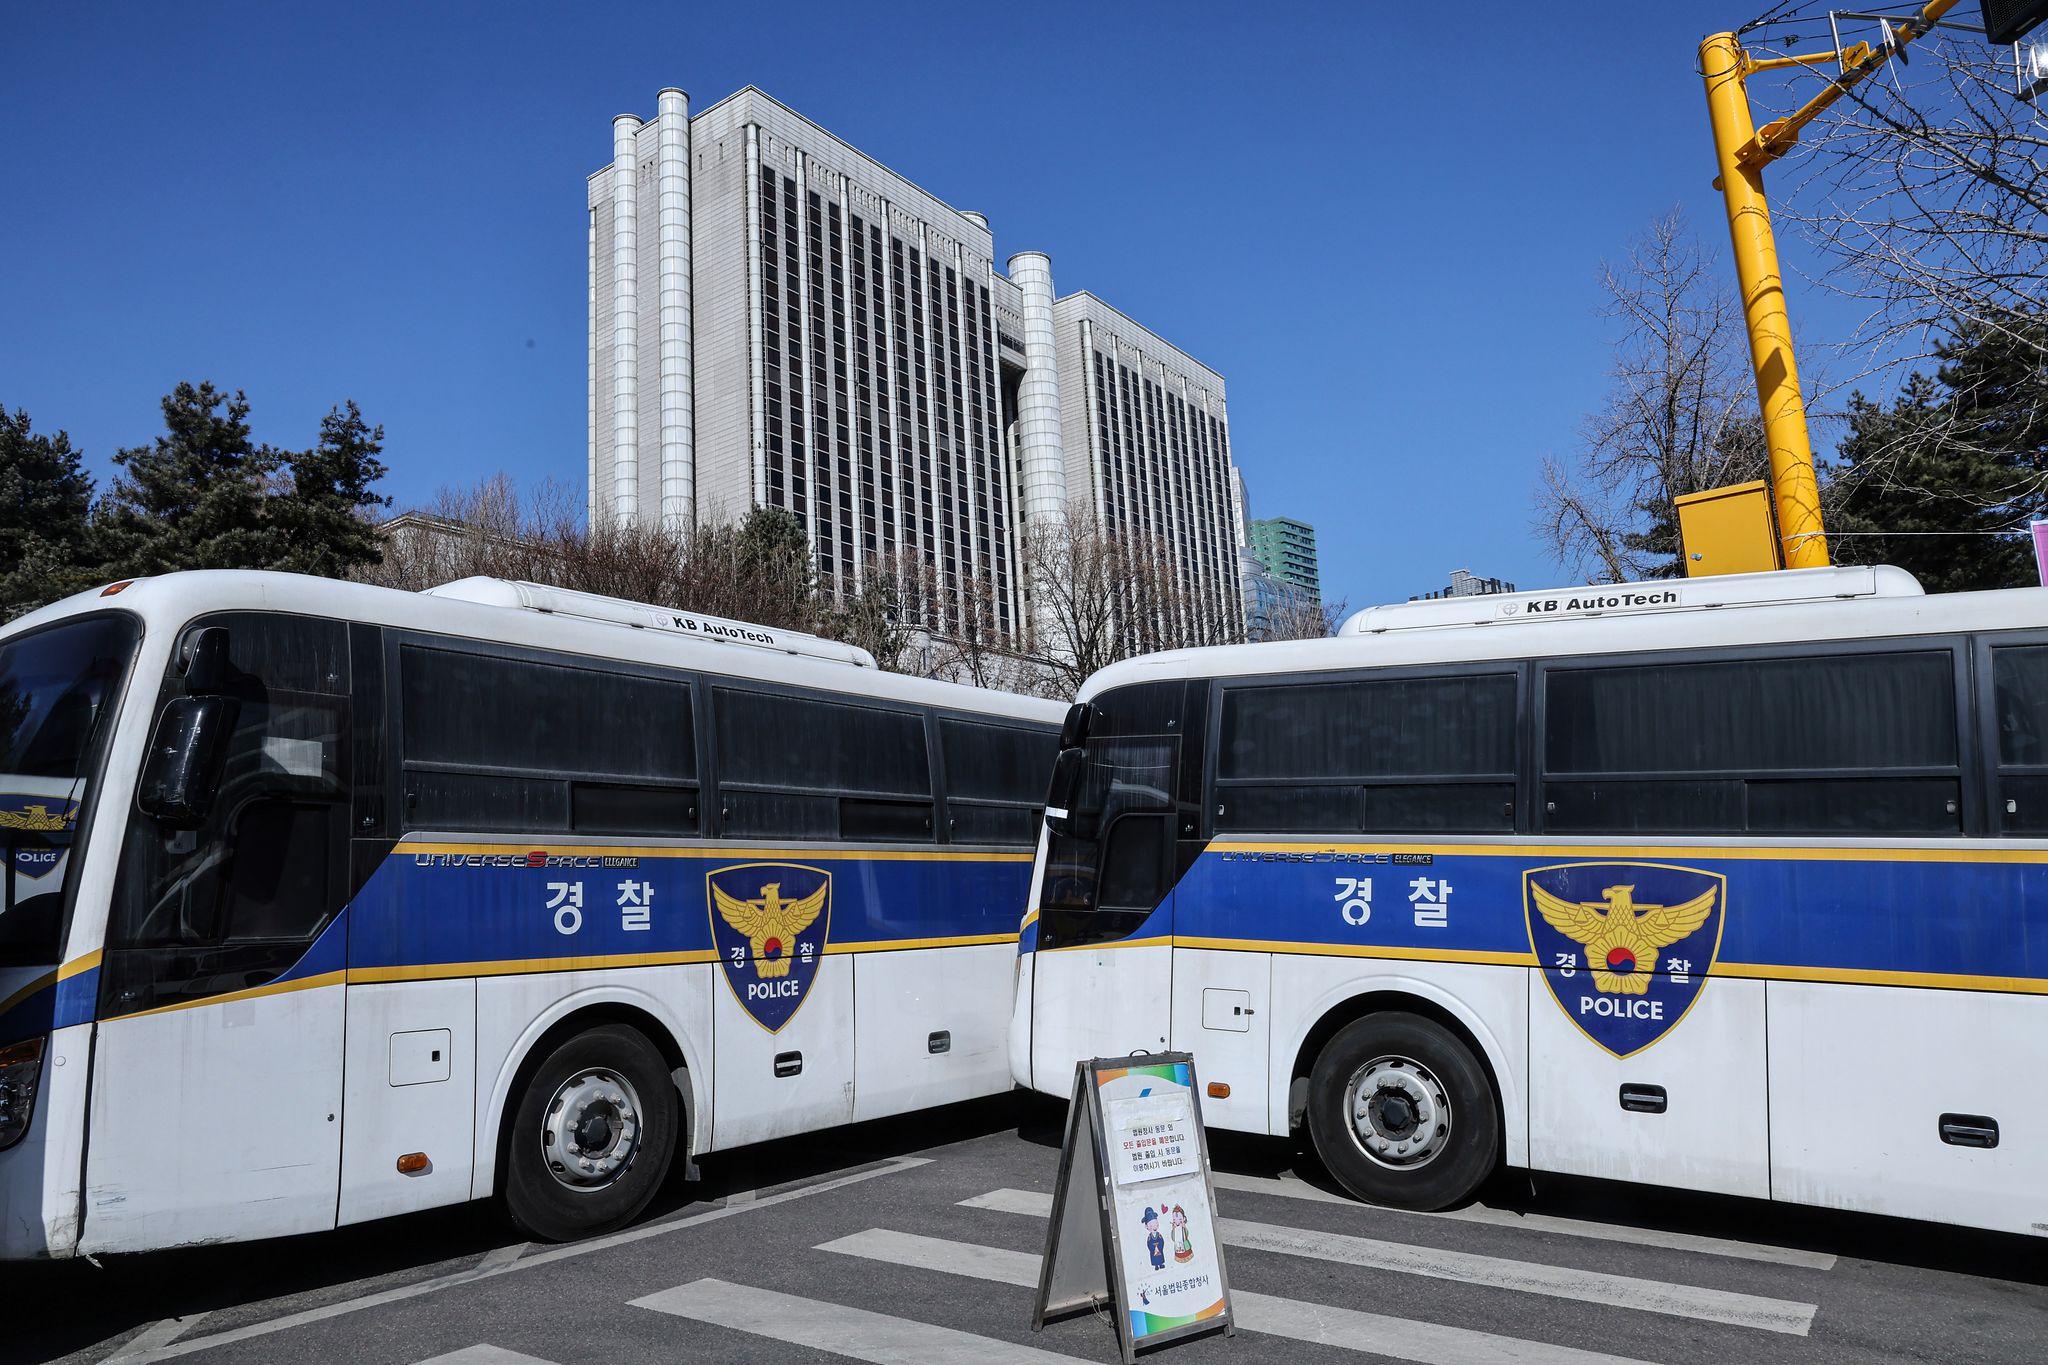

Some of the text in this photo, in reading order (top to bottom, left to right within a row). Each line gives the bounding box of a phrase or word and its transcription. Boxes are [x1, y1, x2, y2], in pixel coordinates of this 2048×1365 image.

[1527, 591, 1677, 613] KB AutoTech
[672, 617, 774, 644] KB AutoTech
[604, 856, 638, 867] ELEGANCE
[1394, 855, 1432, 864] ELEGANCE
[731, 946, 745, 968] 경
[800, 942, 814, 963] 찰
[1555, 952, 1576, 978] 경
[1667, 957, 1691, 984] 찰
[748, 980, 799, 1000] POLICE
[1580, 996, 1663, 1020] POLICE
[1123, 1140, 1134, 1150] 모든
[1132, 1151, 1143, 1161] 법원
[1145, 1149, 1156, 1159] 출입
[1158, 1148, 1164, 1156] 시
[1132, 1161, 1160, 1172] 이용하시기
[1154, 1274, 1209, 1296] 서울법원종합청사
